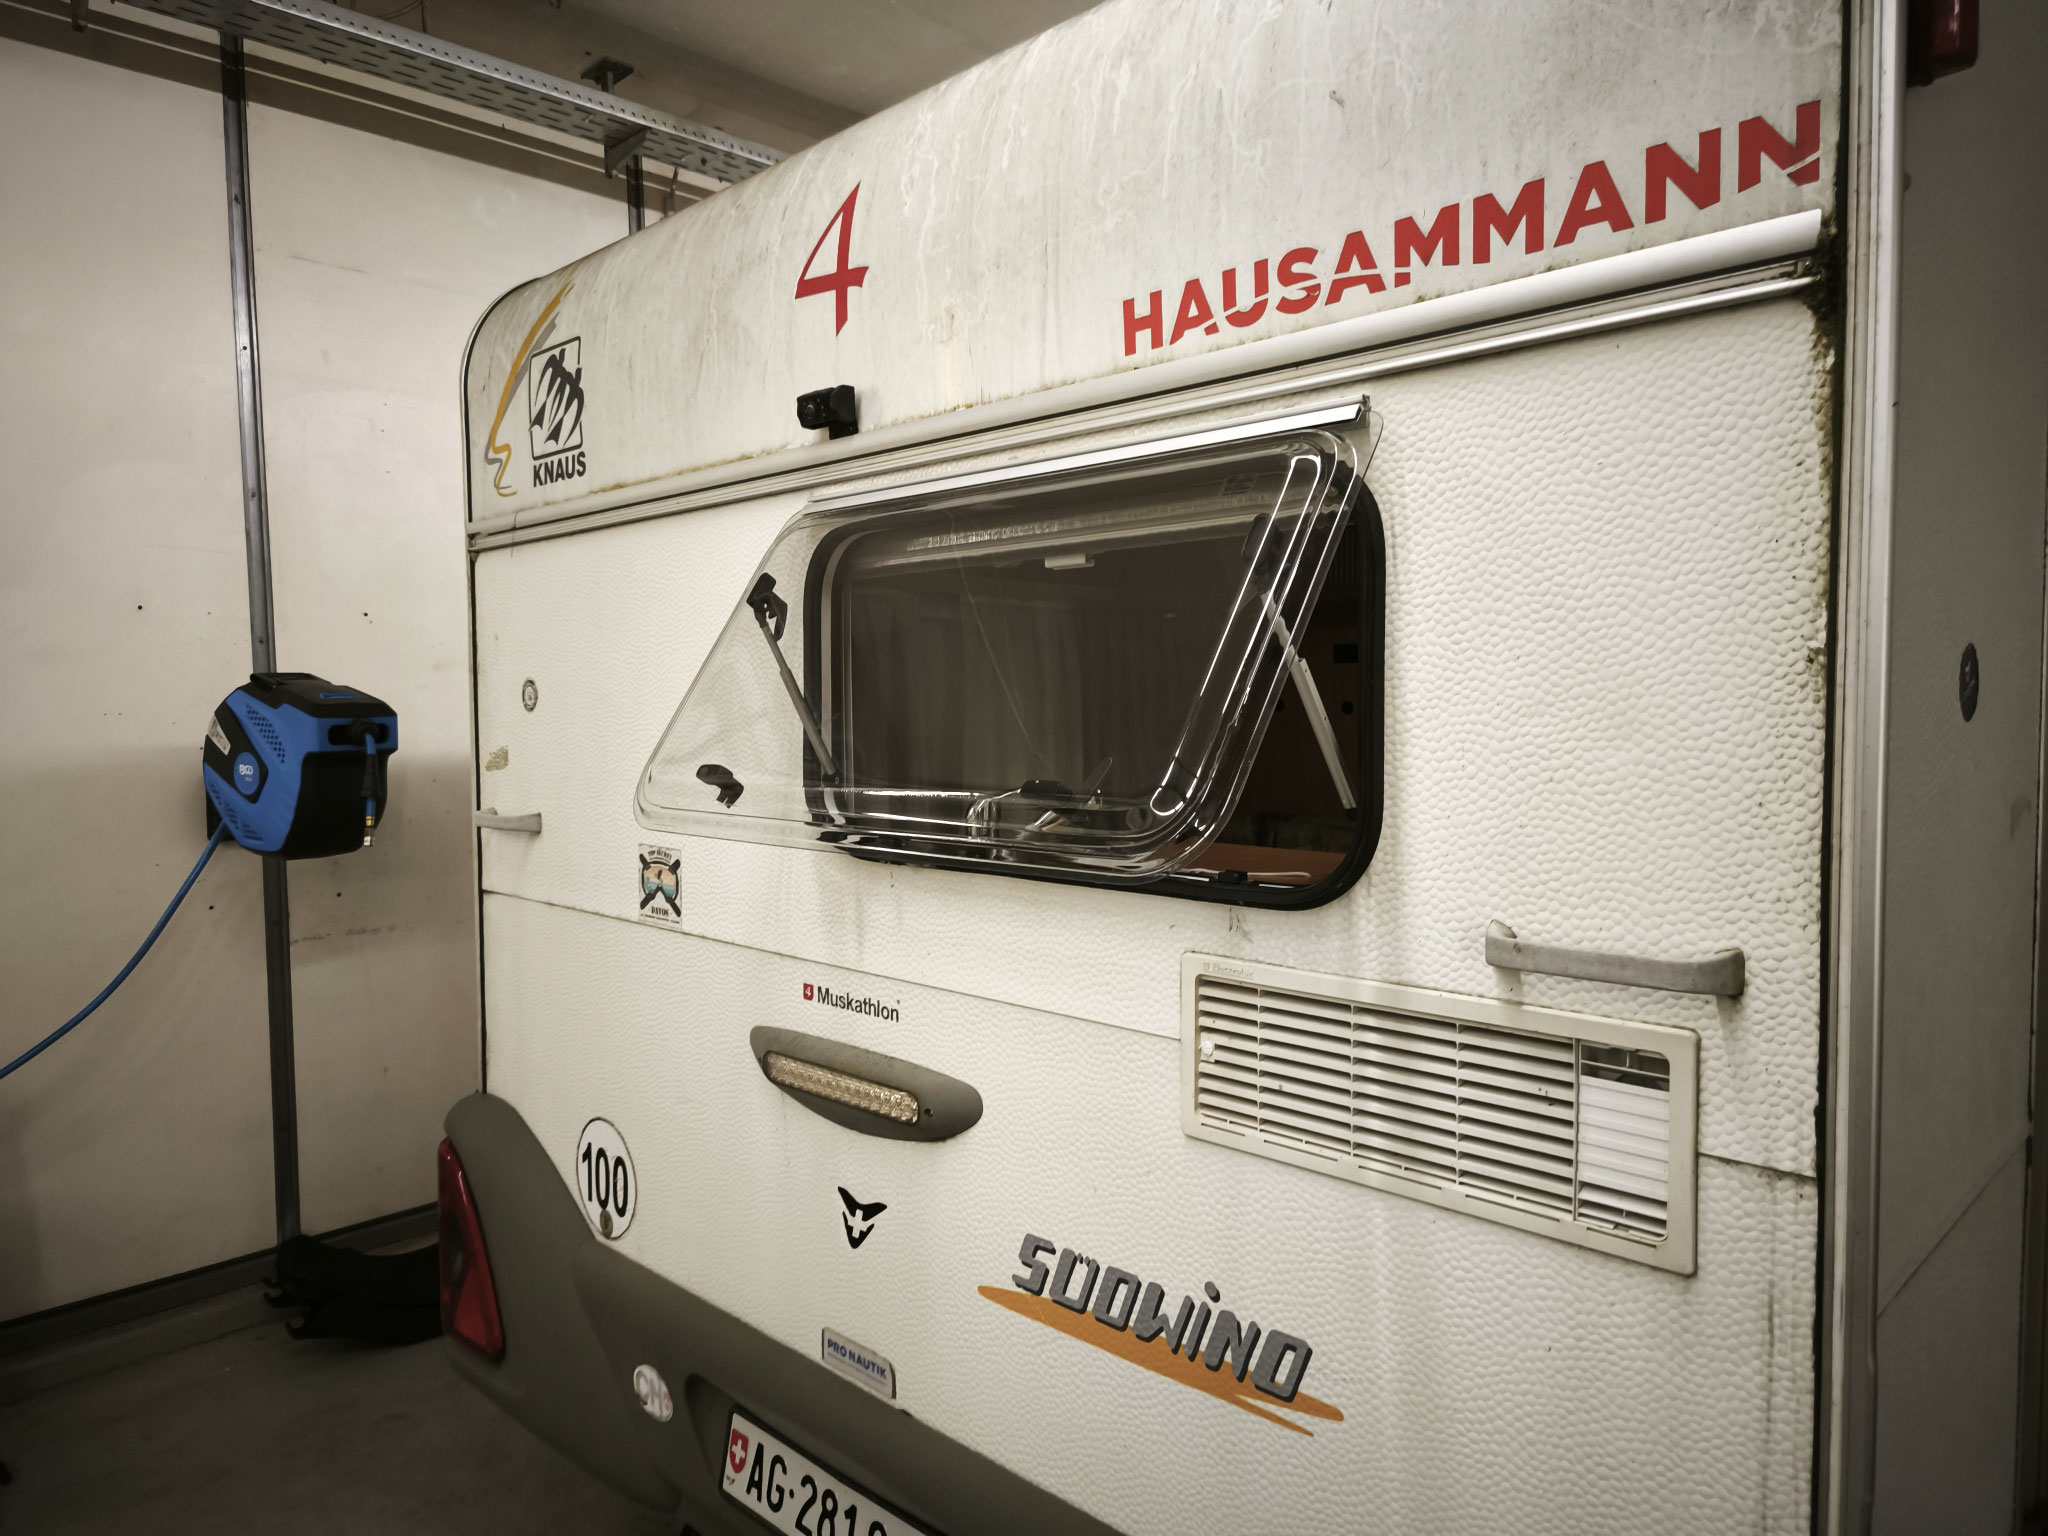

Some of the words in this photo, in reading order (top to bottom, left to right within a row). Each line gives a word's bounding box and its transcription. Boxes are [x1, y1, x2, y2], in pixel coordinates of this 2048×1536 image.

[795, 180, 869, 338] 4
[1123, 100, 1821, 356] HAUSAMMANN
[533, 451, 587, 488] KNAUS
[582, 1142, 629, 1218] 100
[828, 1338, 848, 1358] PRO
[848, 1350, 887, 1380] NAUTIK
